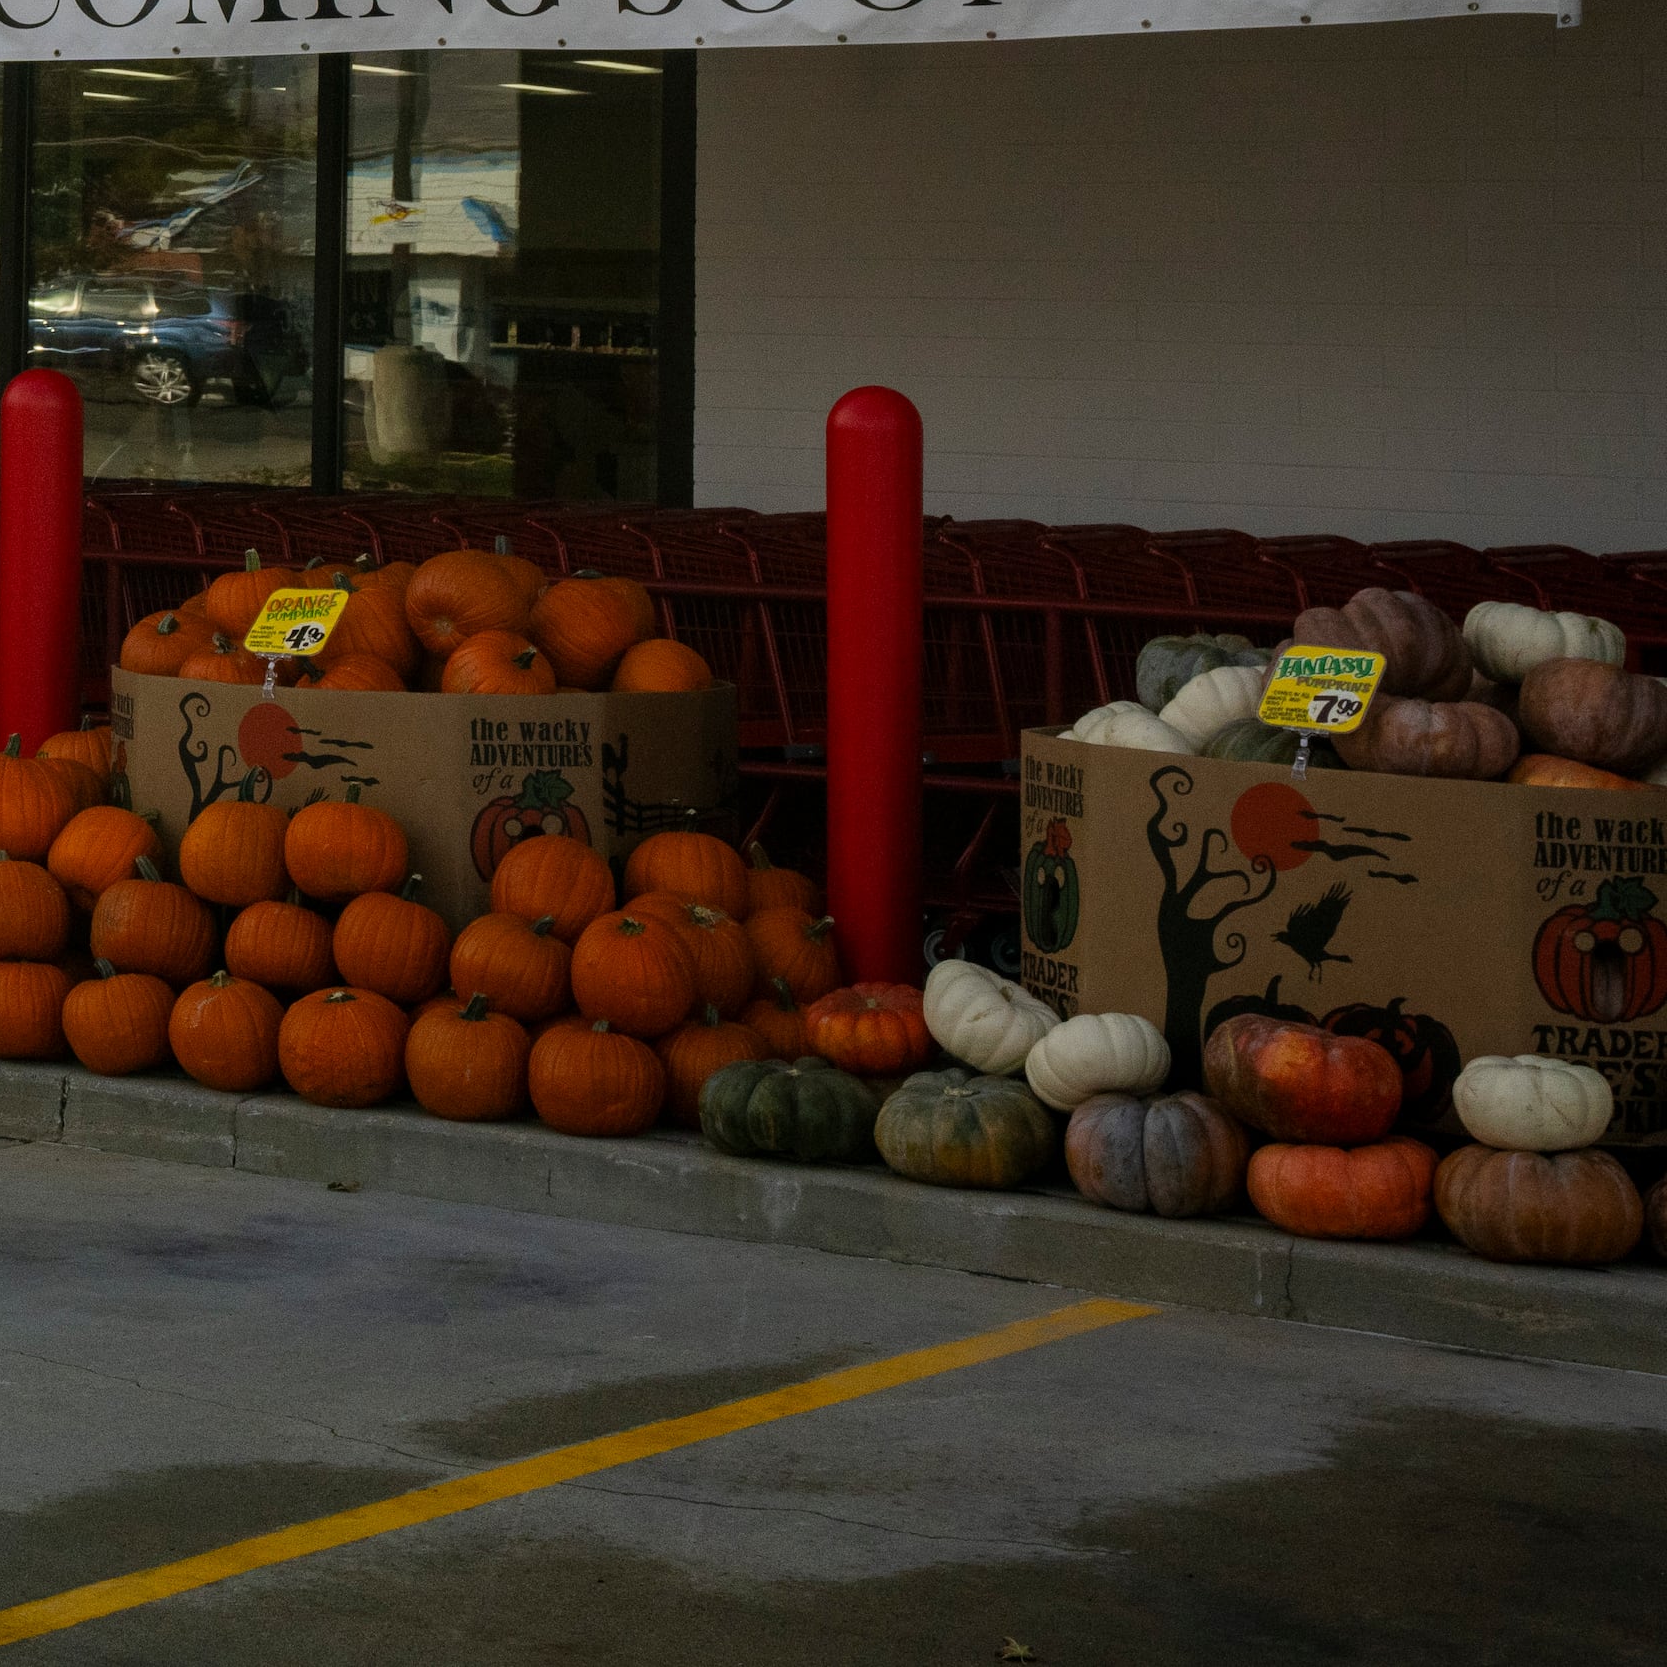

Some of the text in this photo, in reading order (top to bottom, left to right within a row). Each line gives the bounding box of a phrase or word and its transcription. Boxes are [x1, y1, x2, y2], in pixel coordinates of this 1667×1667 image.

[267, 592, 342, 614] ORANGE
[267, 605, 331, 622] PUMPKINS
[1275, 655, 1376, 679] FANTASY
[1295, 676, 1373, 693] PUMPKINS
[470, 718, 591, 745] the wacky
[470, 743, 593, 767] ADVENTURES
[473, 767, 514, 795] of a
[1535, 810, 1665, 845] the wack
[1533, 841, 1667, 874] ADVENTURE
[1536, 870, 1572, 902] of
[1023, 951, 1079, 993] TRADER
